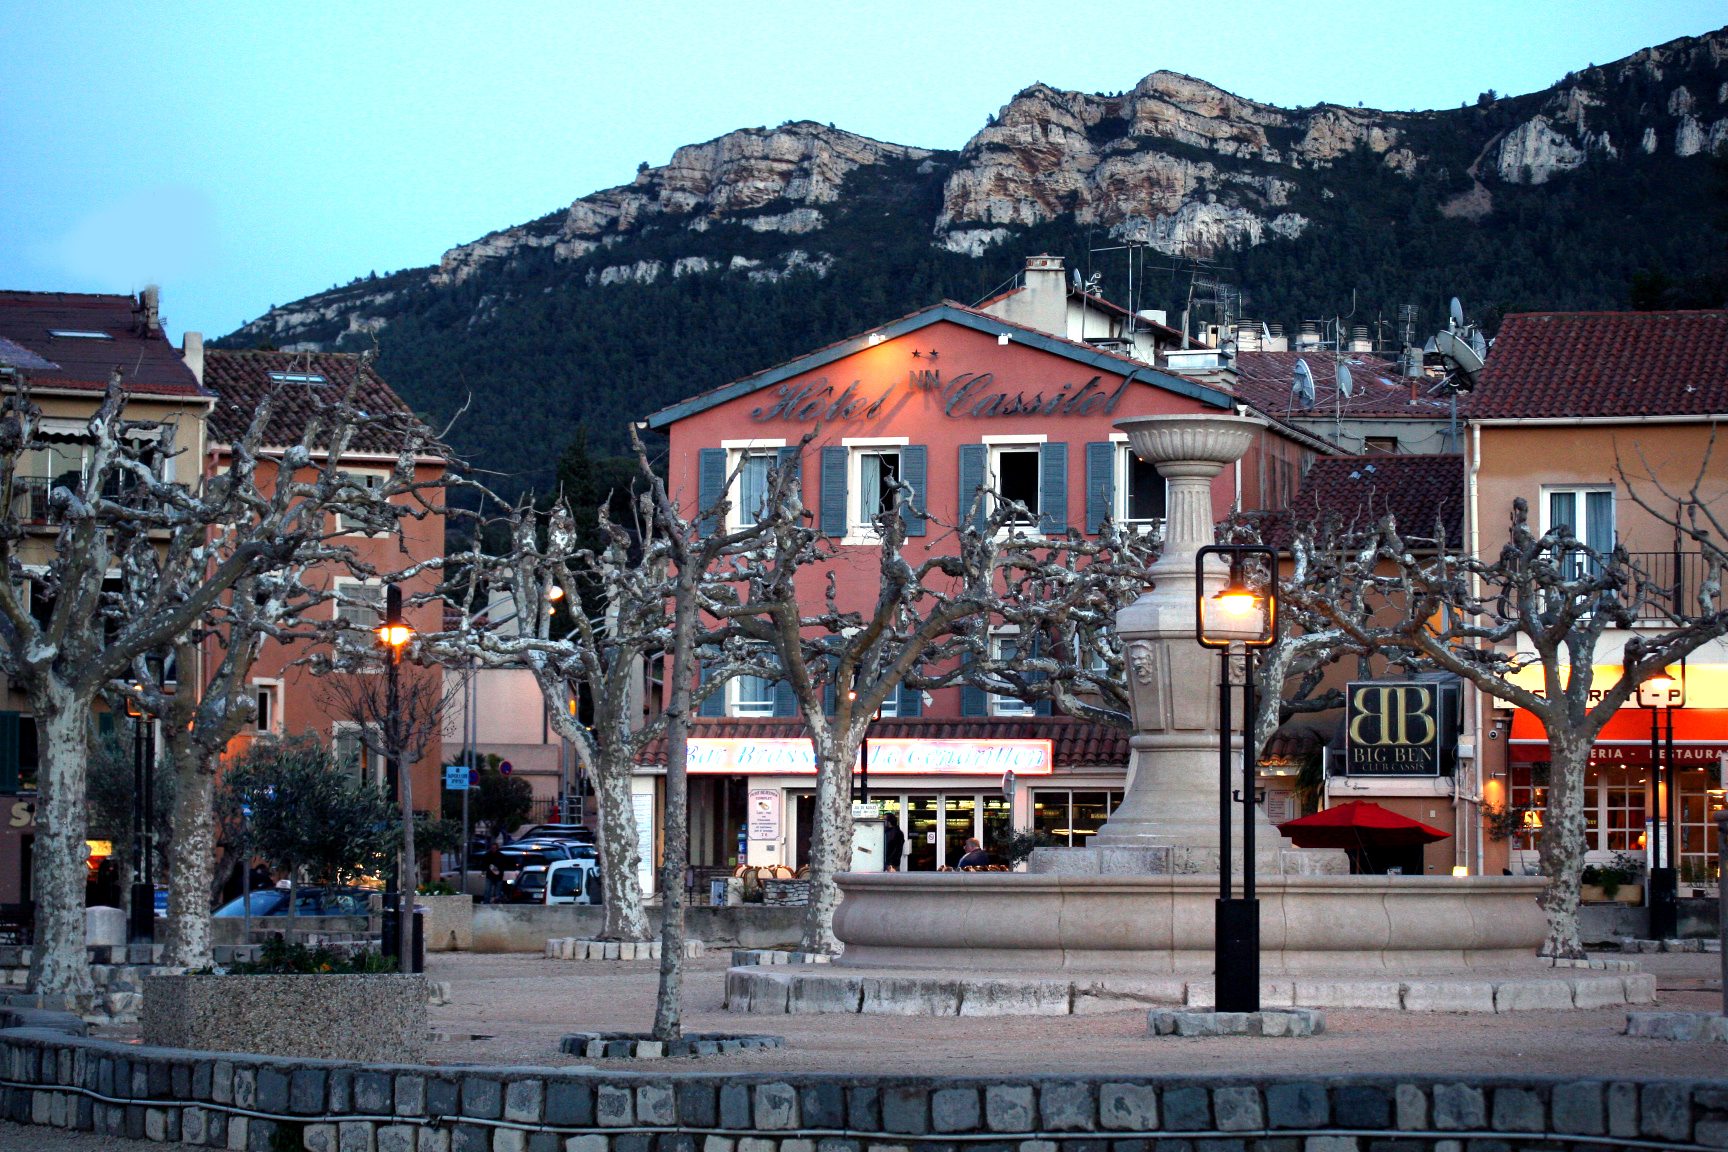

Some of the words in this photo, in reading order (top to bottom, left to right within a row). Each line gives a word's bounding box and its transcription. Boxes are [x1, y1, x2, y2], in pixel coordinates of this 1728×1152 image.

[909, 369, 940, 390] NN
[752, 376, 902, 422] Hôtel
[941, 367, 1142, 419] Cassitel
[686, 745, 728, 765] Bar
[907, 745, 1045, 767] Cendrillon
[1353, 747, 1386, 763] BIG
[1395, 747, 1432, 762] BEN
[1362, 763, 1389, 772] CLUB
[1391, 762, 1425, 771] CASSIS
